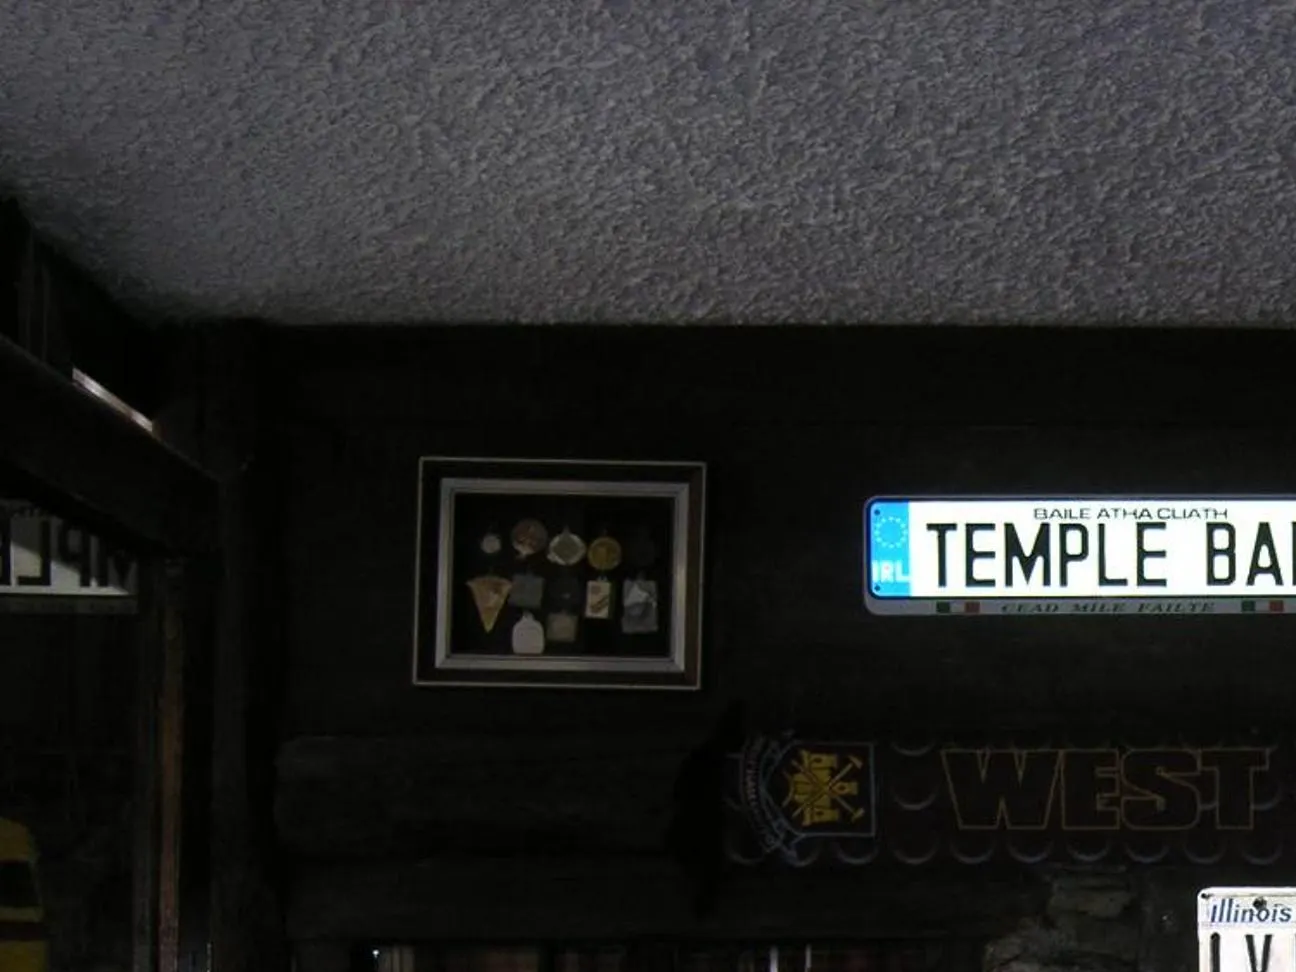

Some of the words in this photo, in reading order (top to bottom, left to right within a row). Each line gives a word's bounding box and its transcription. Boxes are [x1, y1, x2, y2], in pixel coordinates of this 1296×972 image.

[1033, 507, 1092, 520] BAILE
[1095, 507, 1153, 520] ATHA
[1156, 507, 1228, 520] CLIATH
[926, 521, 1168, 588] TEMPLE
[872, 560, 910, 583] IRL
[1070, 602, 1126, 613] MILE
[940, 747, 1273, 832] WEST
[1210, 898, 1293, 924] Illinois
